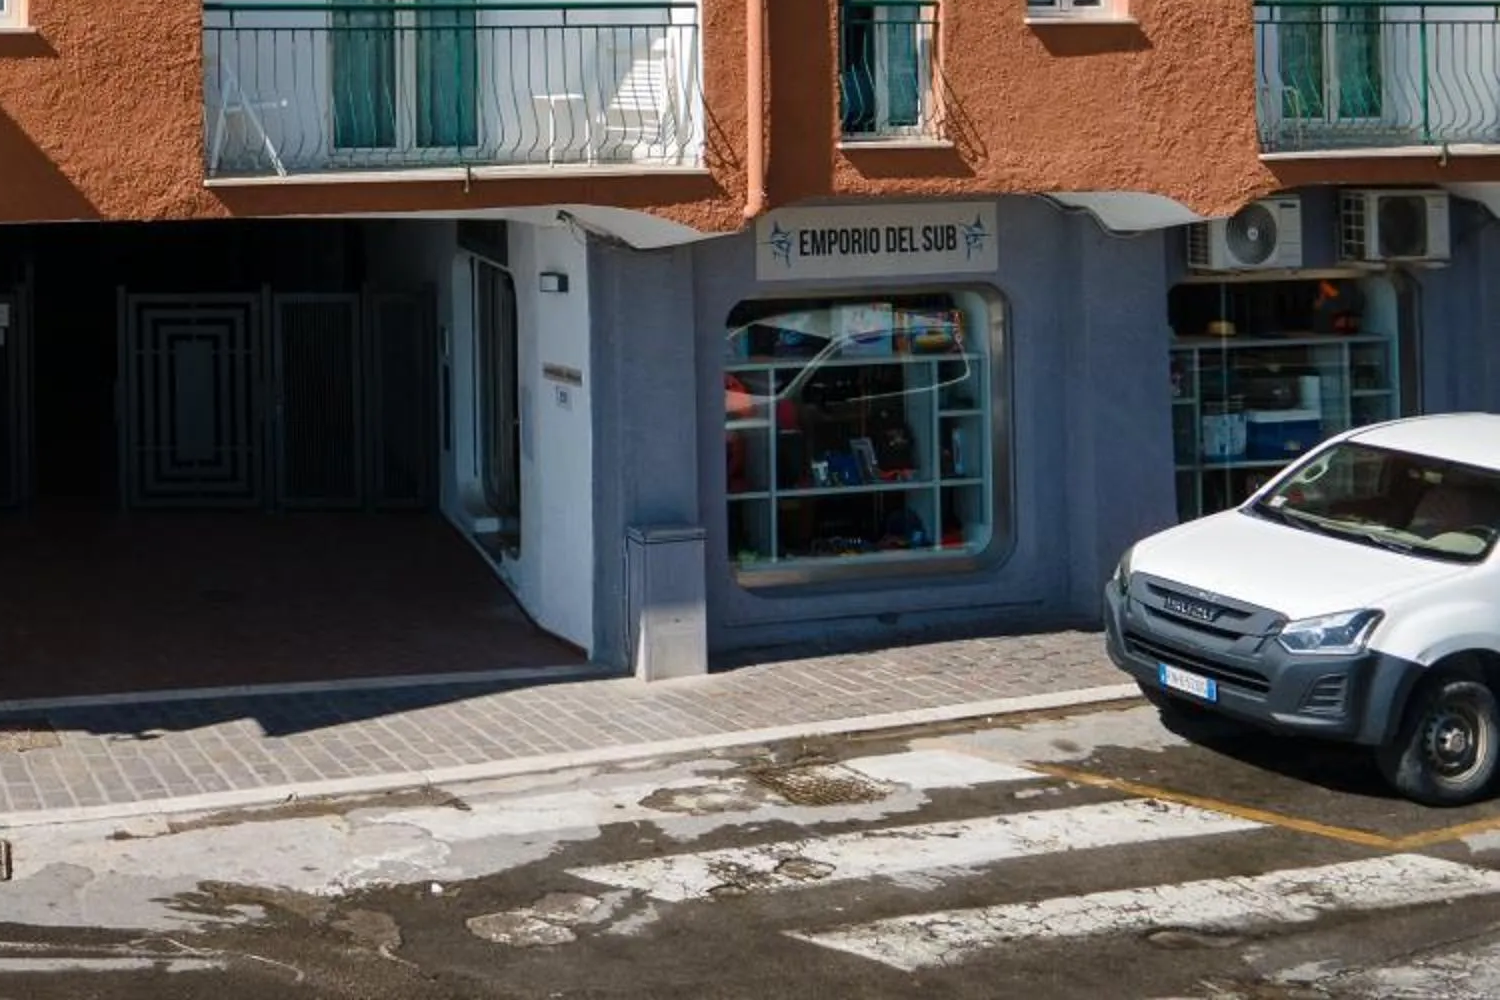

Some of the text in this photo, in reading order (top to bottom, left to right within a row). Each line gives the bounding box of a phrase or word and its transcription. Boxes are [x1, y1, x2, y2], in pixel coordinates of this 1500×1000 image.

[799, 224, 957, 257] EMPORIO DEL SUB
